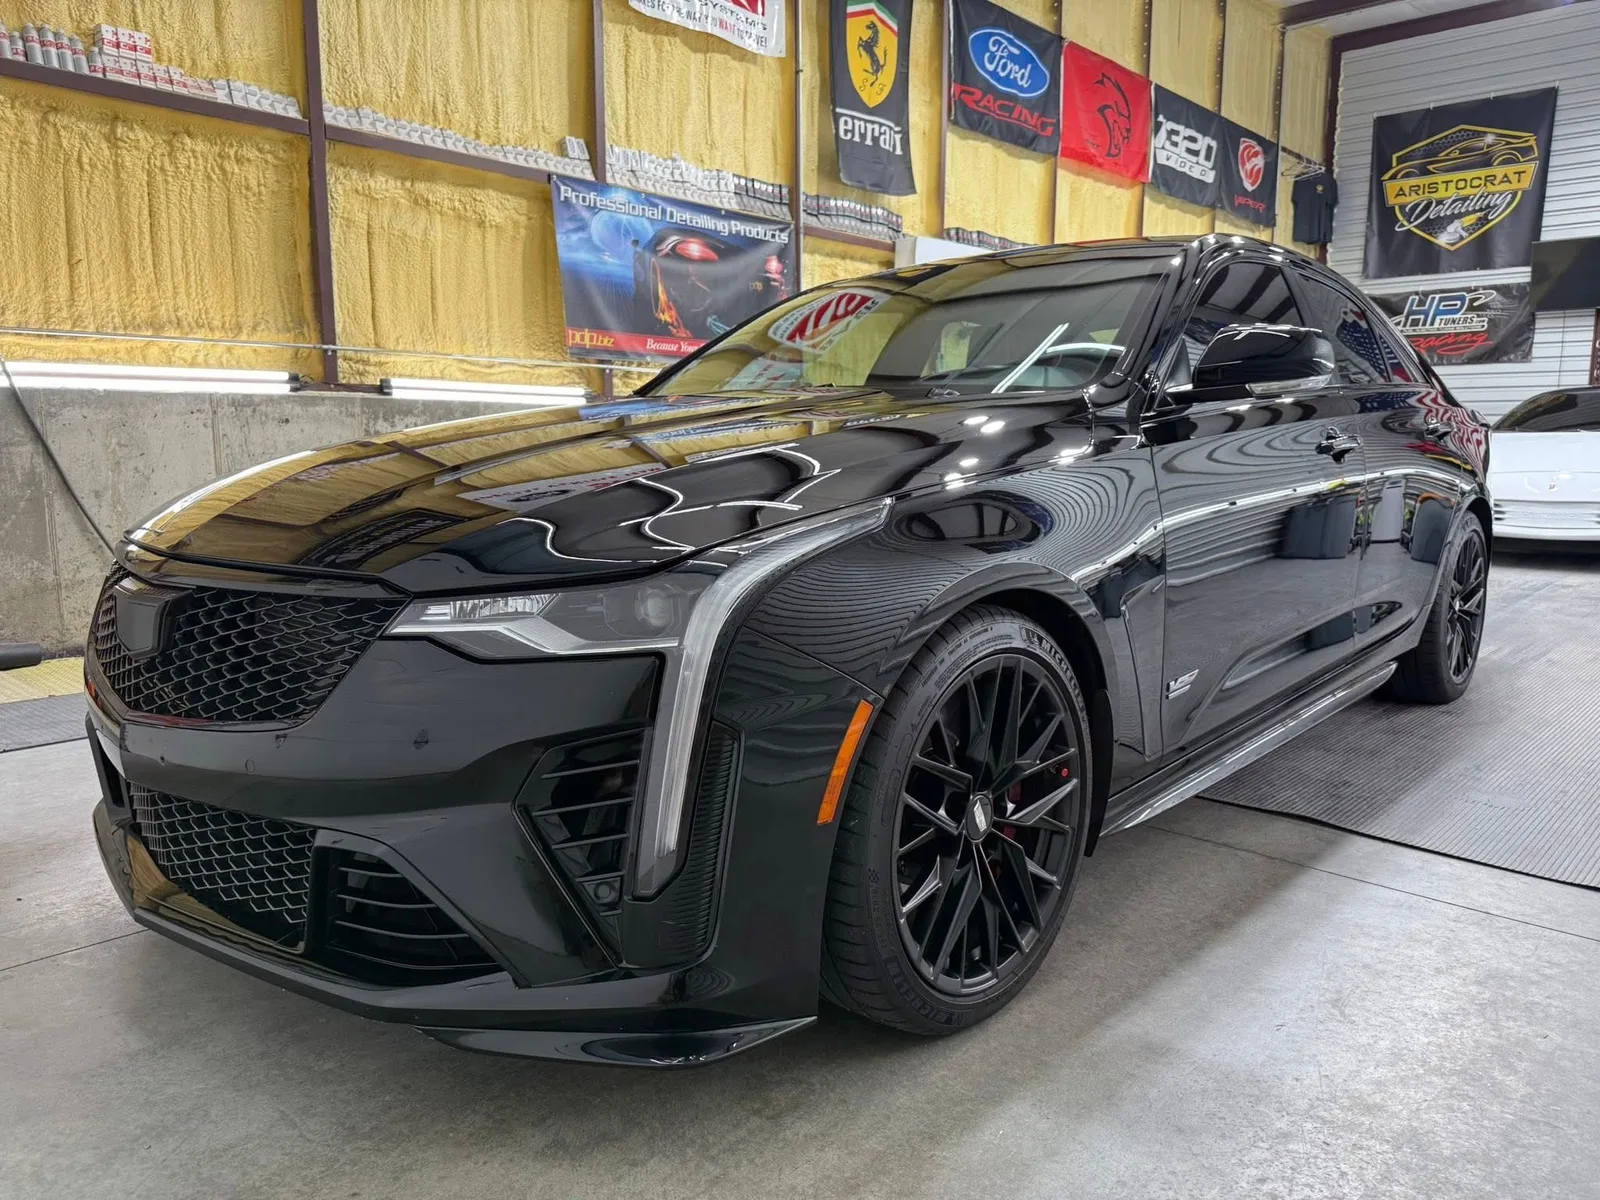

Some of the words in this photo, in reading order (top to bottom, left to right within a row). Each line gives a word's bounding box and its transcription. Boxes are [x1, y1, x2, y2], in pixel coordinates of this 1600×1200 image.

[984, 36, 1032, 88] Ford
[953, 82, 1057, 137] RACING
[1154, 113, 1218, 170] 1320
[1165, 153, 1207, 177] VIDEO
[1393, 170, 1527, 199] ARISTOCRAT
[1394, 186, 1514, 232] Detailing
[559, 185, 663, 221] Professional
[665, 207, 728, 237] Detailing
[730, 220, 790, 244] Products
[646, 338, 679, 352] Because
